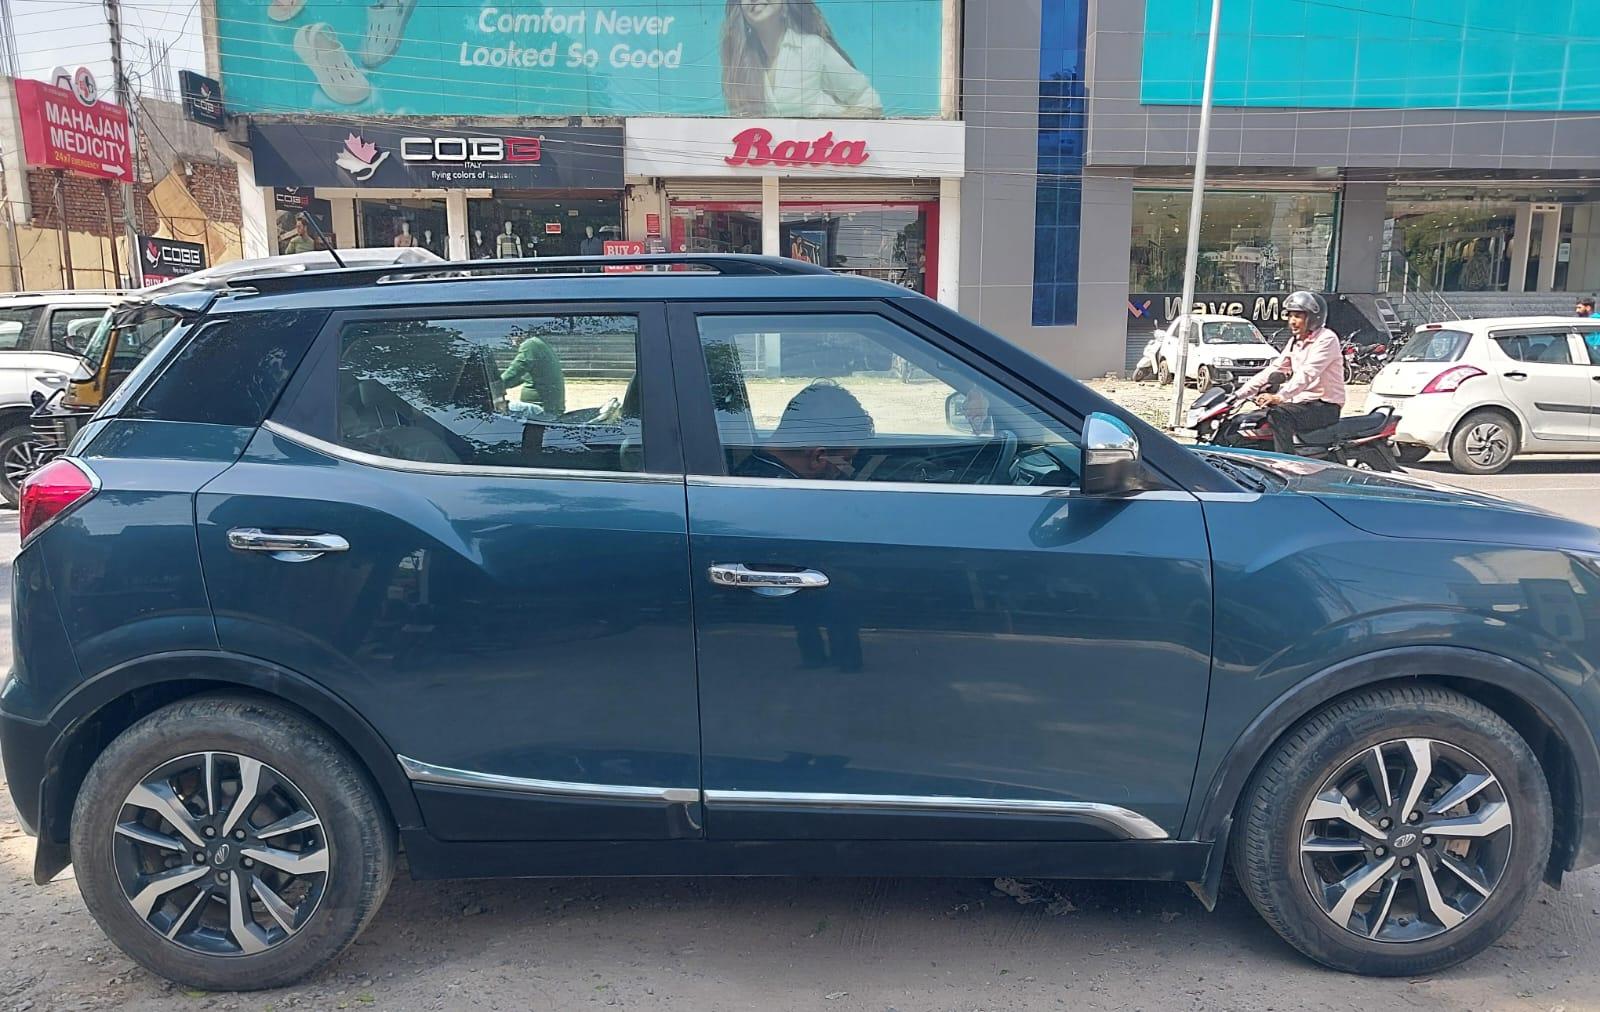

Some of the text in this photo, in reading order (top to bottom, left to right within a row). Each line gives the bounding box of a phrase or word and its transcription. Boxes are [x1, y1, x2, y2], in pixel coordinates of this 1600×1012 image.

[478, 7, 675, 34] Comfort Never
[459, 41, 683, 68] Looked So Good
[45, 101, 125, 142] MAHAJAN
[50, 126, 125, 163] MEDICITY
[400, 137, 542, 161] COBB
[724, 127, 870, 167] Bata
[431, 170, 452, 181] flying
[452, 170, 476, 179] colors
[477, 170, 486, 179] of
[464, 161, 482, 169] ITALY
[161, 246, 201, 264] COBB
[1164, 296, 1244, 320] Wave
